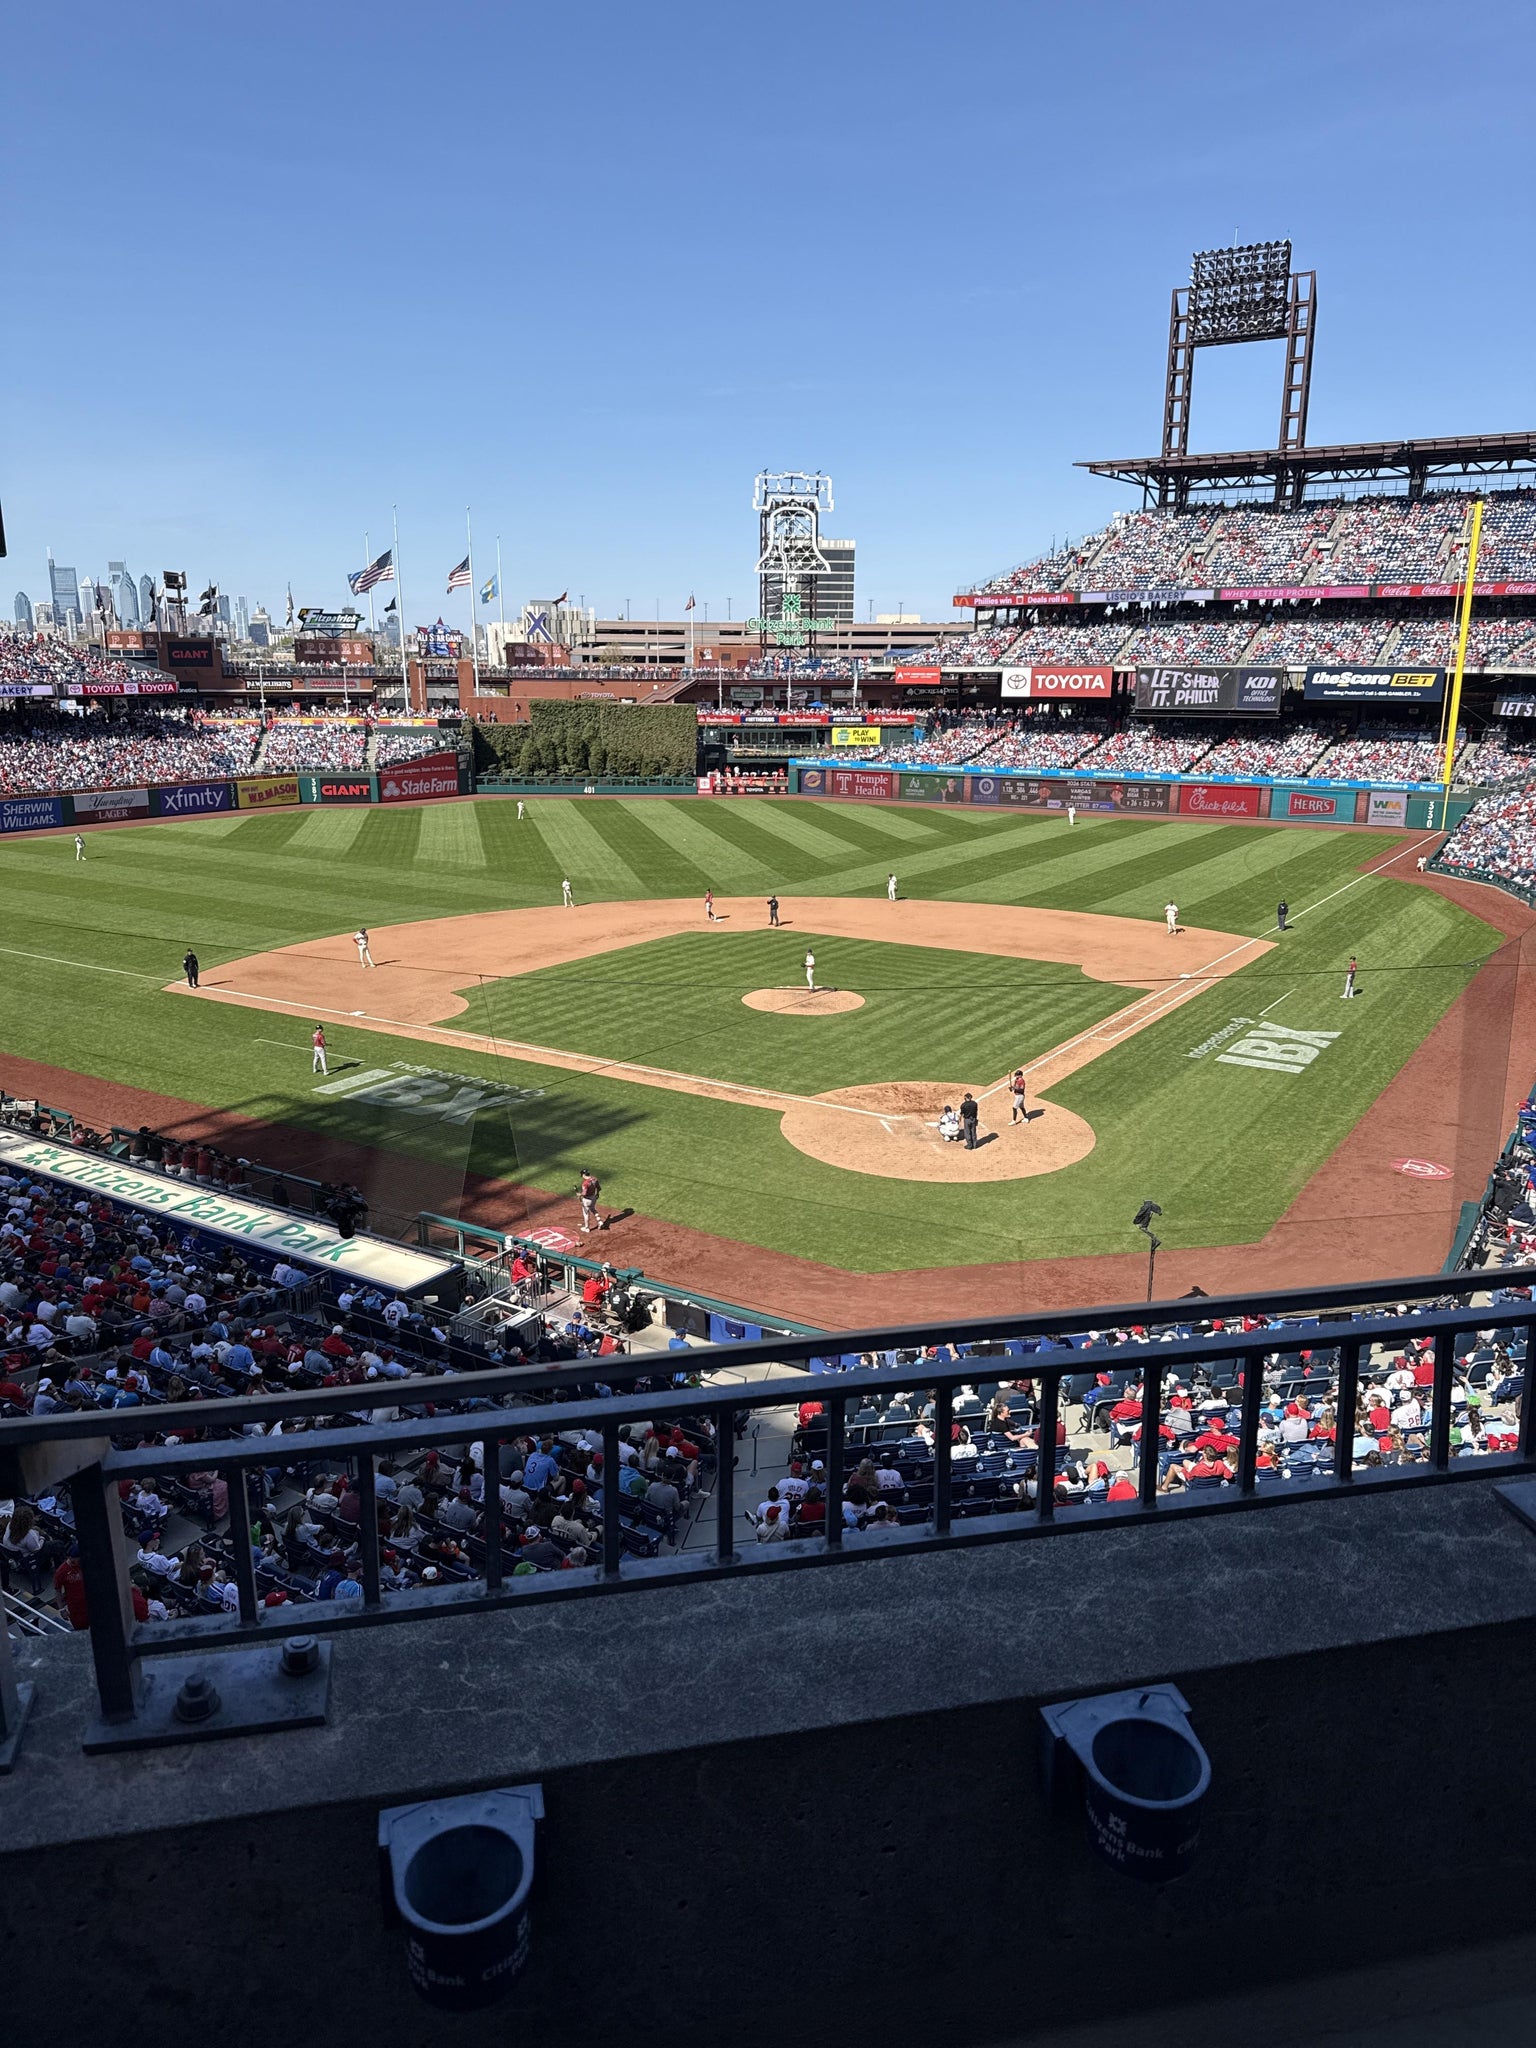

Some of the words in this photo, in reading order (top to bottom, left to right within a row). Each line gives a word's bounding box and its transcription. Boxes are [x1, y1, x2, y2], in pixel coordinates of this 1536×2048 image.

[974, 597, 998, 605] Phillies
[1106, 592, 1145, 600] LISCIO'S
[1148, 591, 1186, 600] BAKERY
[303, 609, 357, 625] Fitzpatrick
[748, 617, 799, 631] Citizens
[802, 617, 834, 631] Bank
[446, 634, 462, 642] GAME
[776, 632, 805, 646] Park
[172, 650, 208, 659] GIANT
[1035, 674, 1105, 690] TOYOTA
[1151, 669, 1192, 688] LET'S
[1194, 674, 1220, 688] HEAR
[1312, 671, 1391, 687] theScore
[1395, 675, 1432, 685] BET
[86, 685, 121, 693] TOYOTA
[141, 683, 175, 692] TOYOTA
[1152, 690, 1170, 707] IT,
[1174, 689, 1219, 706] PHILLY!
[1500, 701, 1534, 717] LET'S
[853, 729, 869, 737] PLAY
[855, 774, 889, 785] Temple
[321, 784, 370, 796] GIANT
[584, 786, 595, 794] 401
[855, 785, 886, 796] Health
[89, 795, 135, 809] Yuengling
[165, 787, 224, 811] xfinity
[1189, 787, 1248, 813] Chick-fil-A
[1294, 799, 1330, 811] HERR'S
[1373, 800, 1401, 809] WM
[3, 802, 53, 816] SHERWIN
[98, 809, 128, 820] LAGER
[1426, 801, 1435, 828] 330
[1214, 1021, 1343, 1074] IBX
[50, 1159, 180, 1204] Citizens
[170, 1195, 273, 1234] Bank
[260, 1222, 360, 1262] Park
[387, 1309, 397, 1321] 12
[527, 1461, 536, 1474] 3
[1126, 1841, 1164, 1858] Bank
[427, 1968, 466, 1986] Bank
